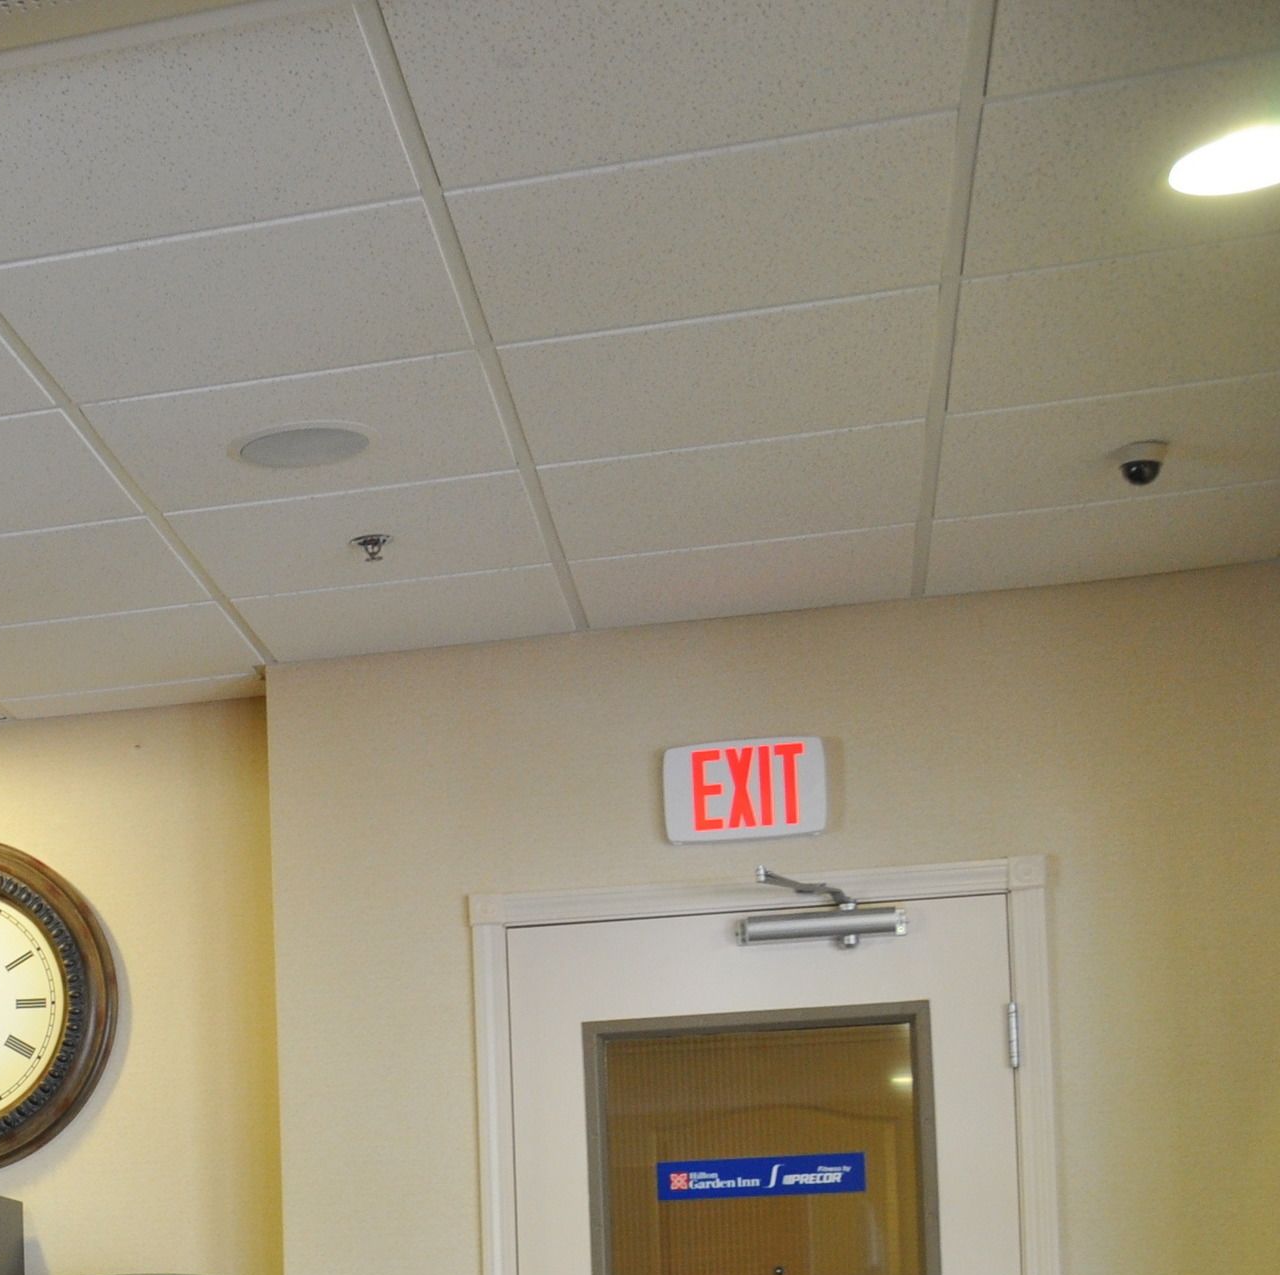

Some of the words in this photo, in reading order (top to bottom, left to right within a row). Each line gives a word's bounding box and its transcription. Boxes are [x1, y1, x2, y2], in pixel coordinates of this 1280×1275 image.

[691, 742, 805, 832] EXIT
[15, 998, 46, 1009] III
[688, 1177, 736, 1190] Garden
[737, 1177, 761, 1188] Inn
[790, 1172, 842, 1184] PRECOR
